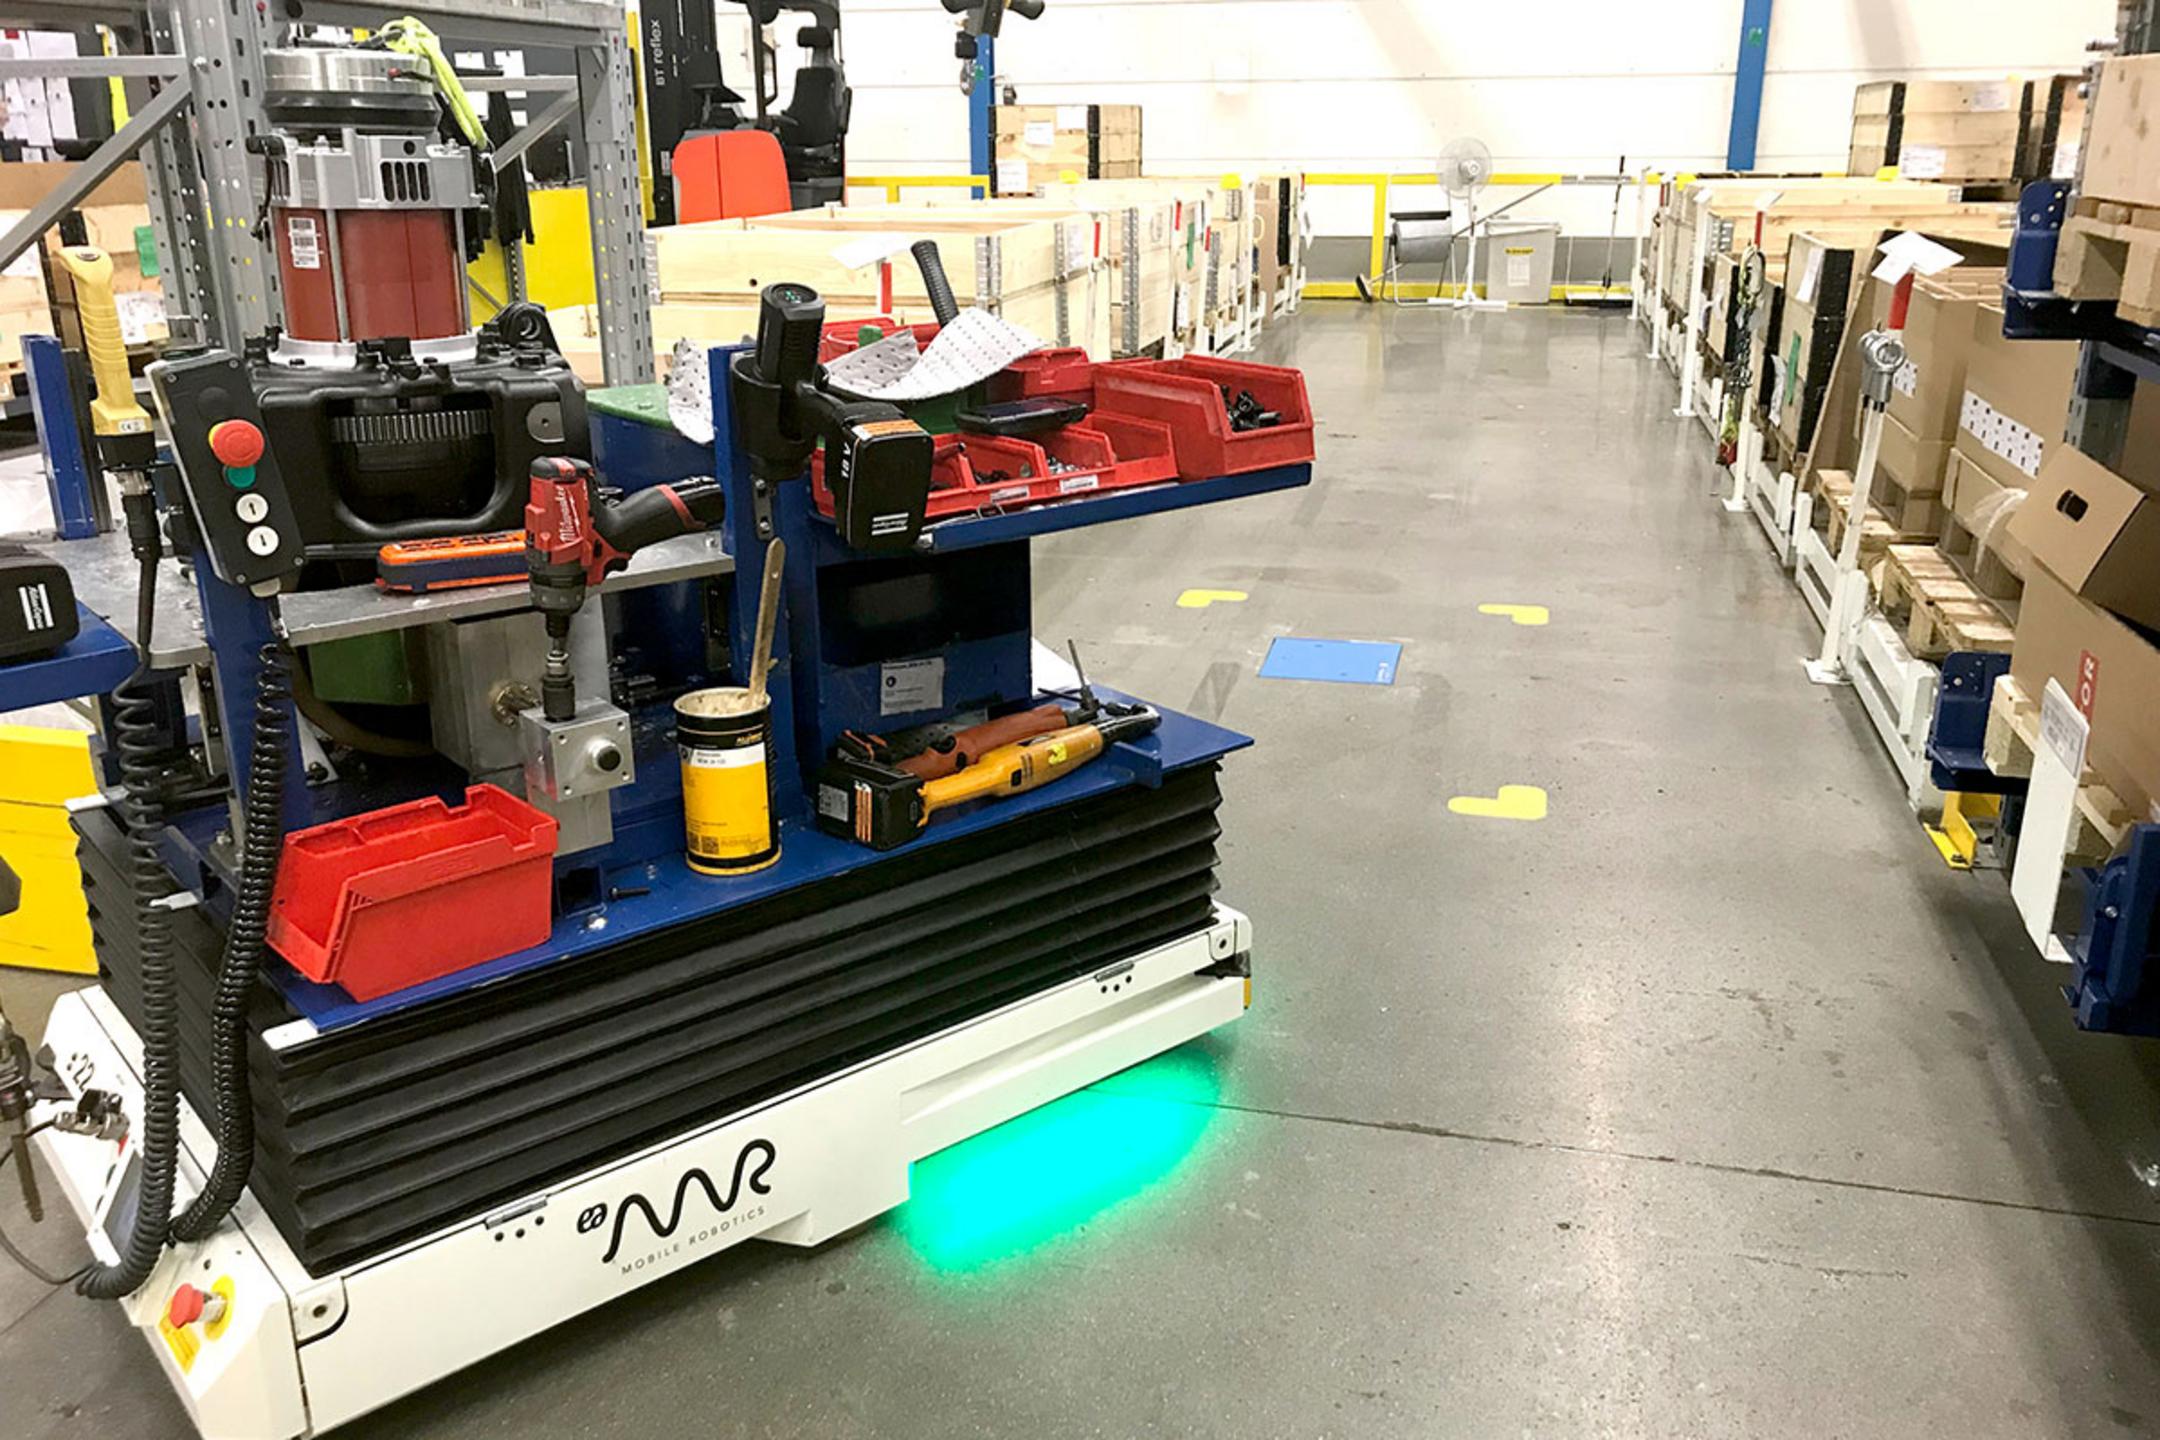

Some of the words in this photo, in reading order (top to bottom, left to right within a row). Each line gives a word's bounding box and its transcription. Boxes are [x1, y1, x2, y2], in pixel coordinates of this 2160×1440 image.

[650, 19, 664, 64] reflex
[653, 67, 666, 86] BT
[621, 1242, 680, 1275] MOBILE
[688, 1205, 765, 1246] ROBOTICS
